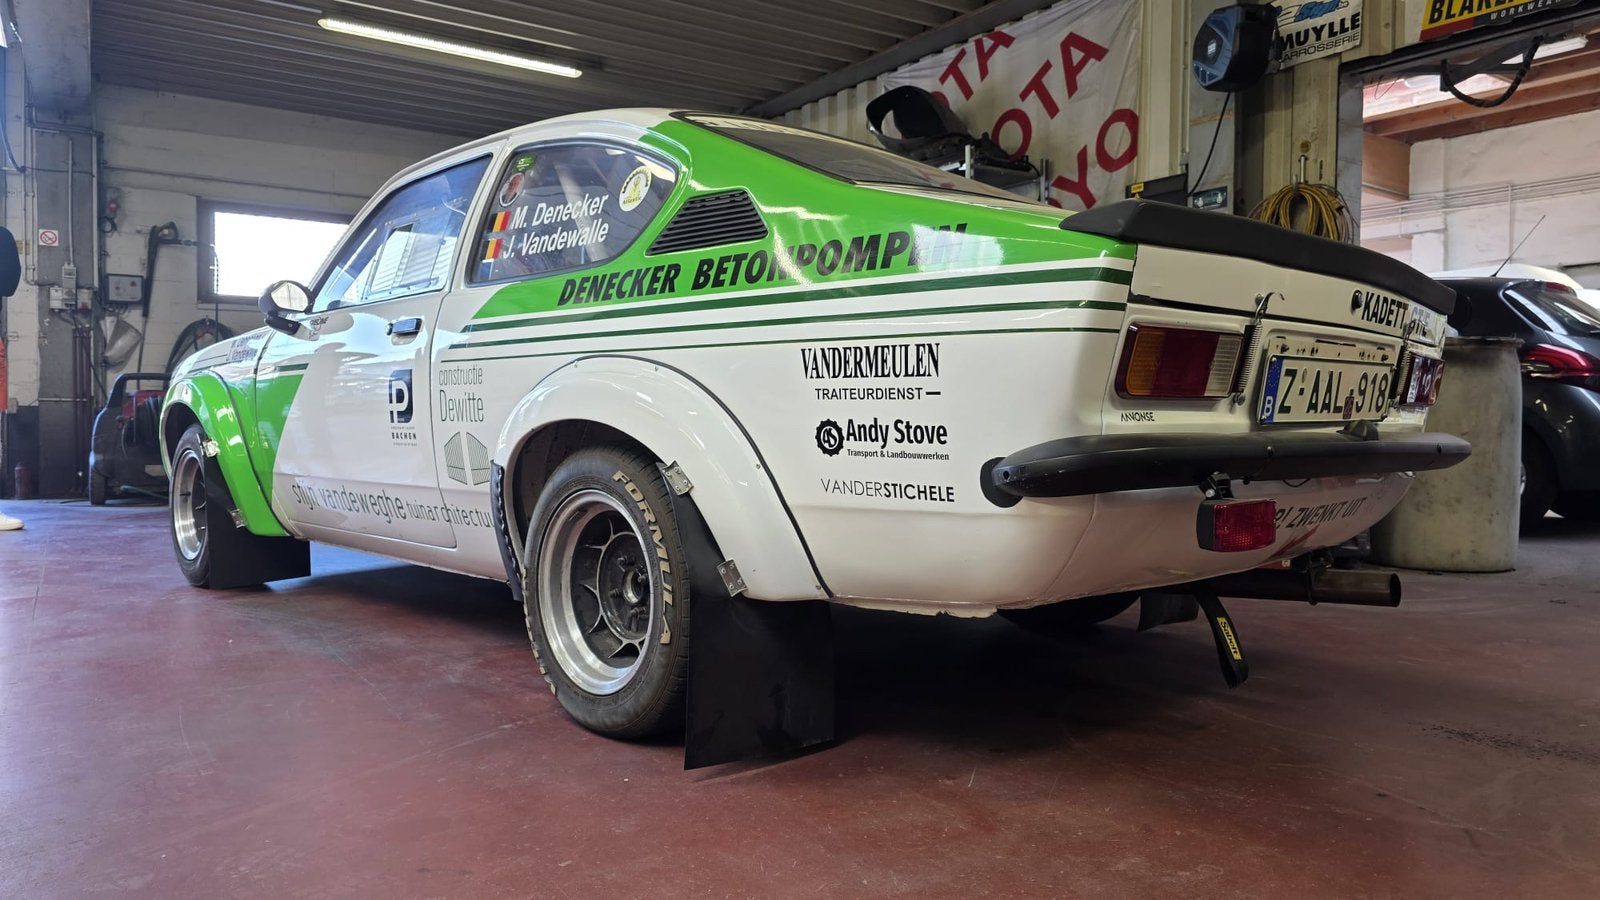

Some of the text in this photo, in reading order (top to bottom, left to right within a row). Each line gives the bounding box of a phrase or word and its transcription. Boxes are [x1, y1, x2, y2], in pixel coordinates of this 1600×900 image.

[1280, 12, 1361, 52] MUYLLE
[1281, 32, 1360, 62] ARROSSERIE
[1048, 108, 1139, 209] YO
[511, 193, 609, 230] M. Denecker
[503, 219, 609, 259] J. Vandewalle
[557, 263, 681, 307] DENECKER
[1361, 291, 1409, 330] KADETT
[439, 366, 483, 386] constructie
[801, 343, 940, 379] VANDERMEULEN
[440, 389, 484, 423] Dewitte
[815, 387, 923, 400] TRAITEURDIENST
[1264, 396, 1273, 417] B
[846, 417, 889, 450] Andy
[893, 419, 948, 445] Stove
[847, 448, 879, 459] Transport
[887, 450, 950, 461] Landbouwwerken
[320, 485, 407, 524] vandeweghe
[820, 478, 955, 503] VANDERSTICHELE
[1285, 501, 1349, 528] ZWENKT
[1342, 496, 1368, 518] UIT
[612, 470, 674, 645] FORMULA
